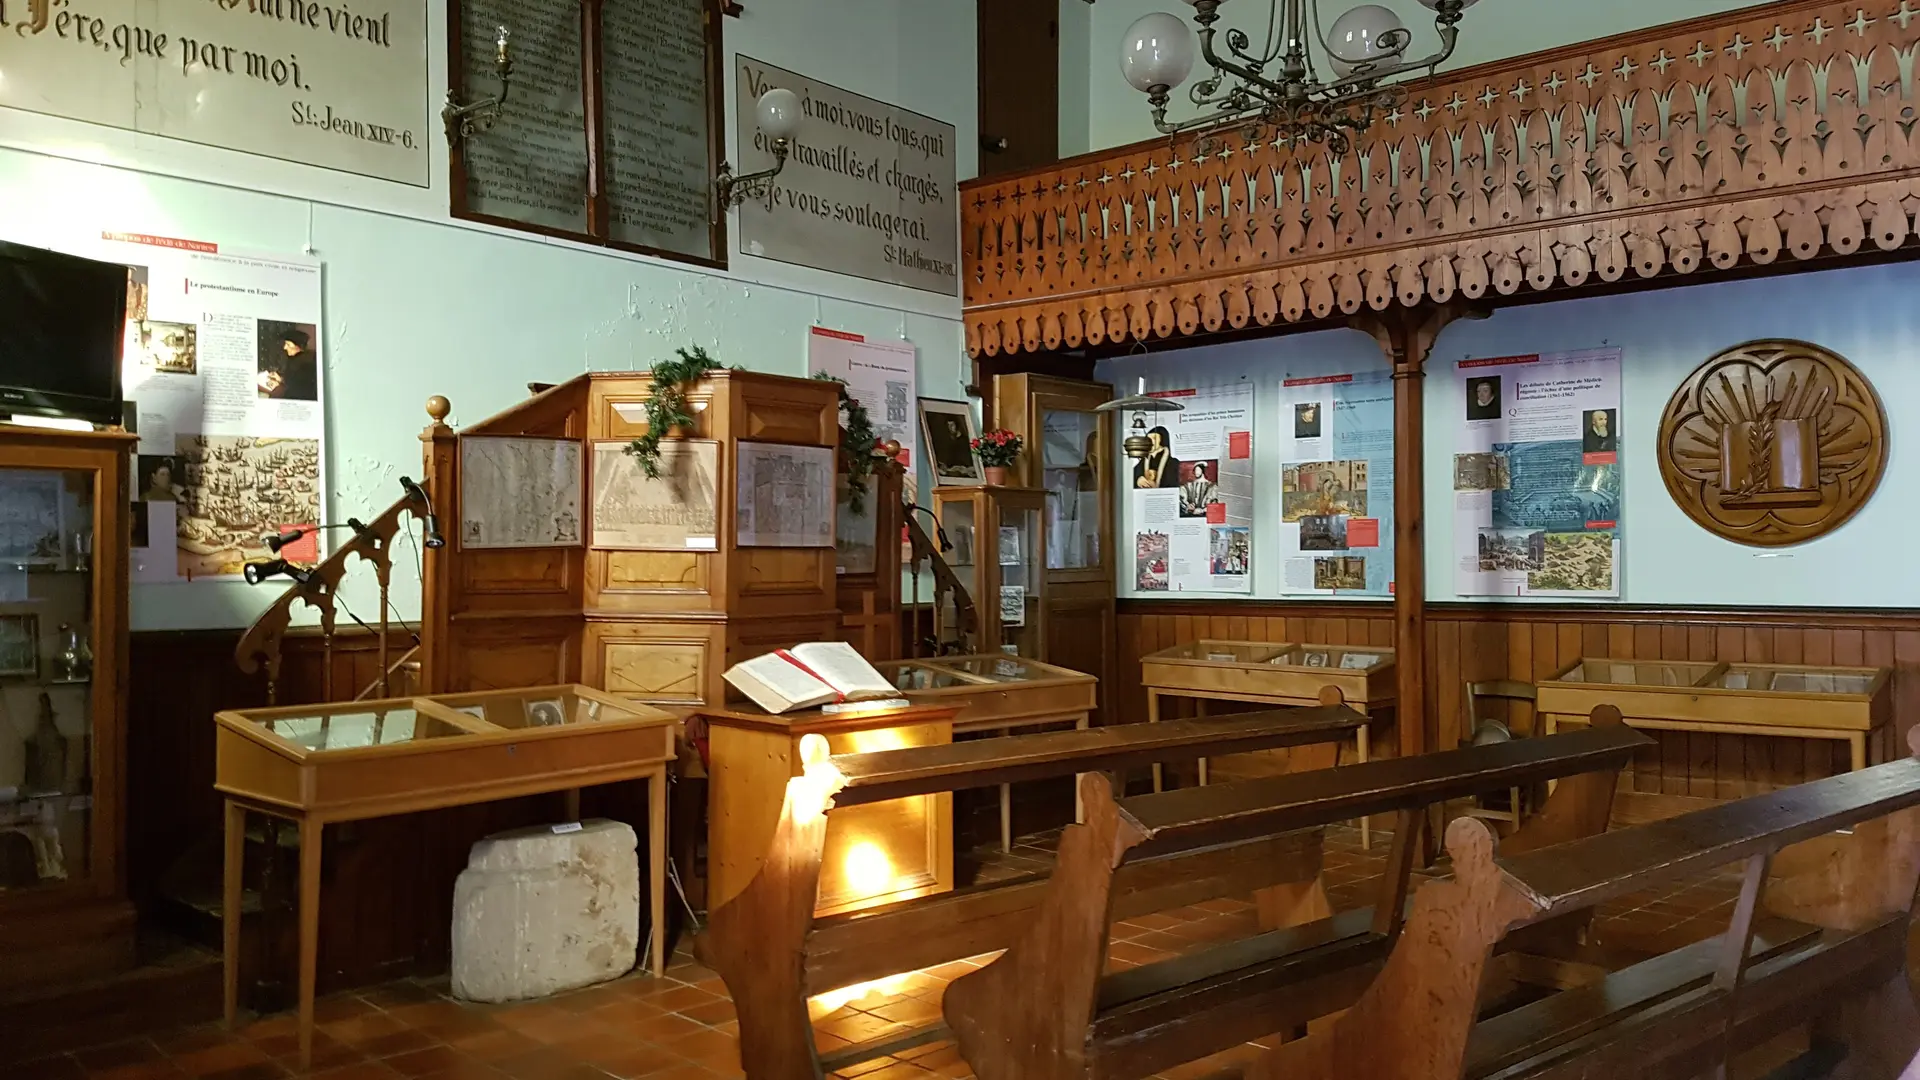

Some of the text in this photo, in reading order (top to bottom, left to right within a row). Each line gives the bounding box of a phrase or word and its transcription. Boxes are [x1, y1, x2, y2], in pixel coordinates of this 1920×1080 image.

[323, 3, 391, 48] vient
[178, 37, 238, 77] par
[242, 53, 312, 92] moi.
[801, 87, 813, 117] à
[848, 109, 883, 139] vous
[792, 137, 866, 181] travaillés
[867, 157, 879, 184] et
[786, 188, 831, 220] vous
[833, 201, 930, 242] soulagerai.
[190, 280, 199, 288] Le
[200, 283, 246, 294] protestantisme
[256, 287, 279, 298] Europe
